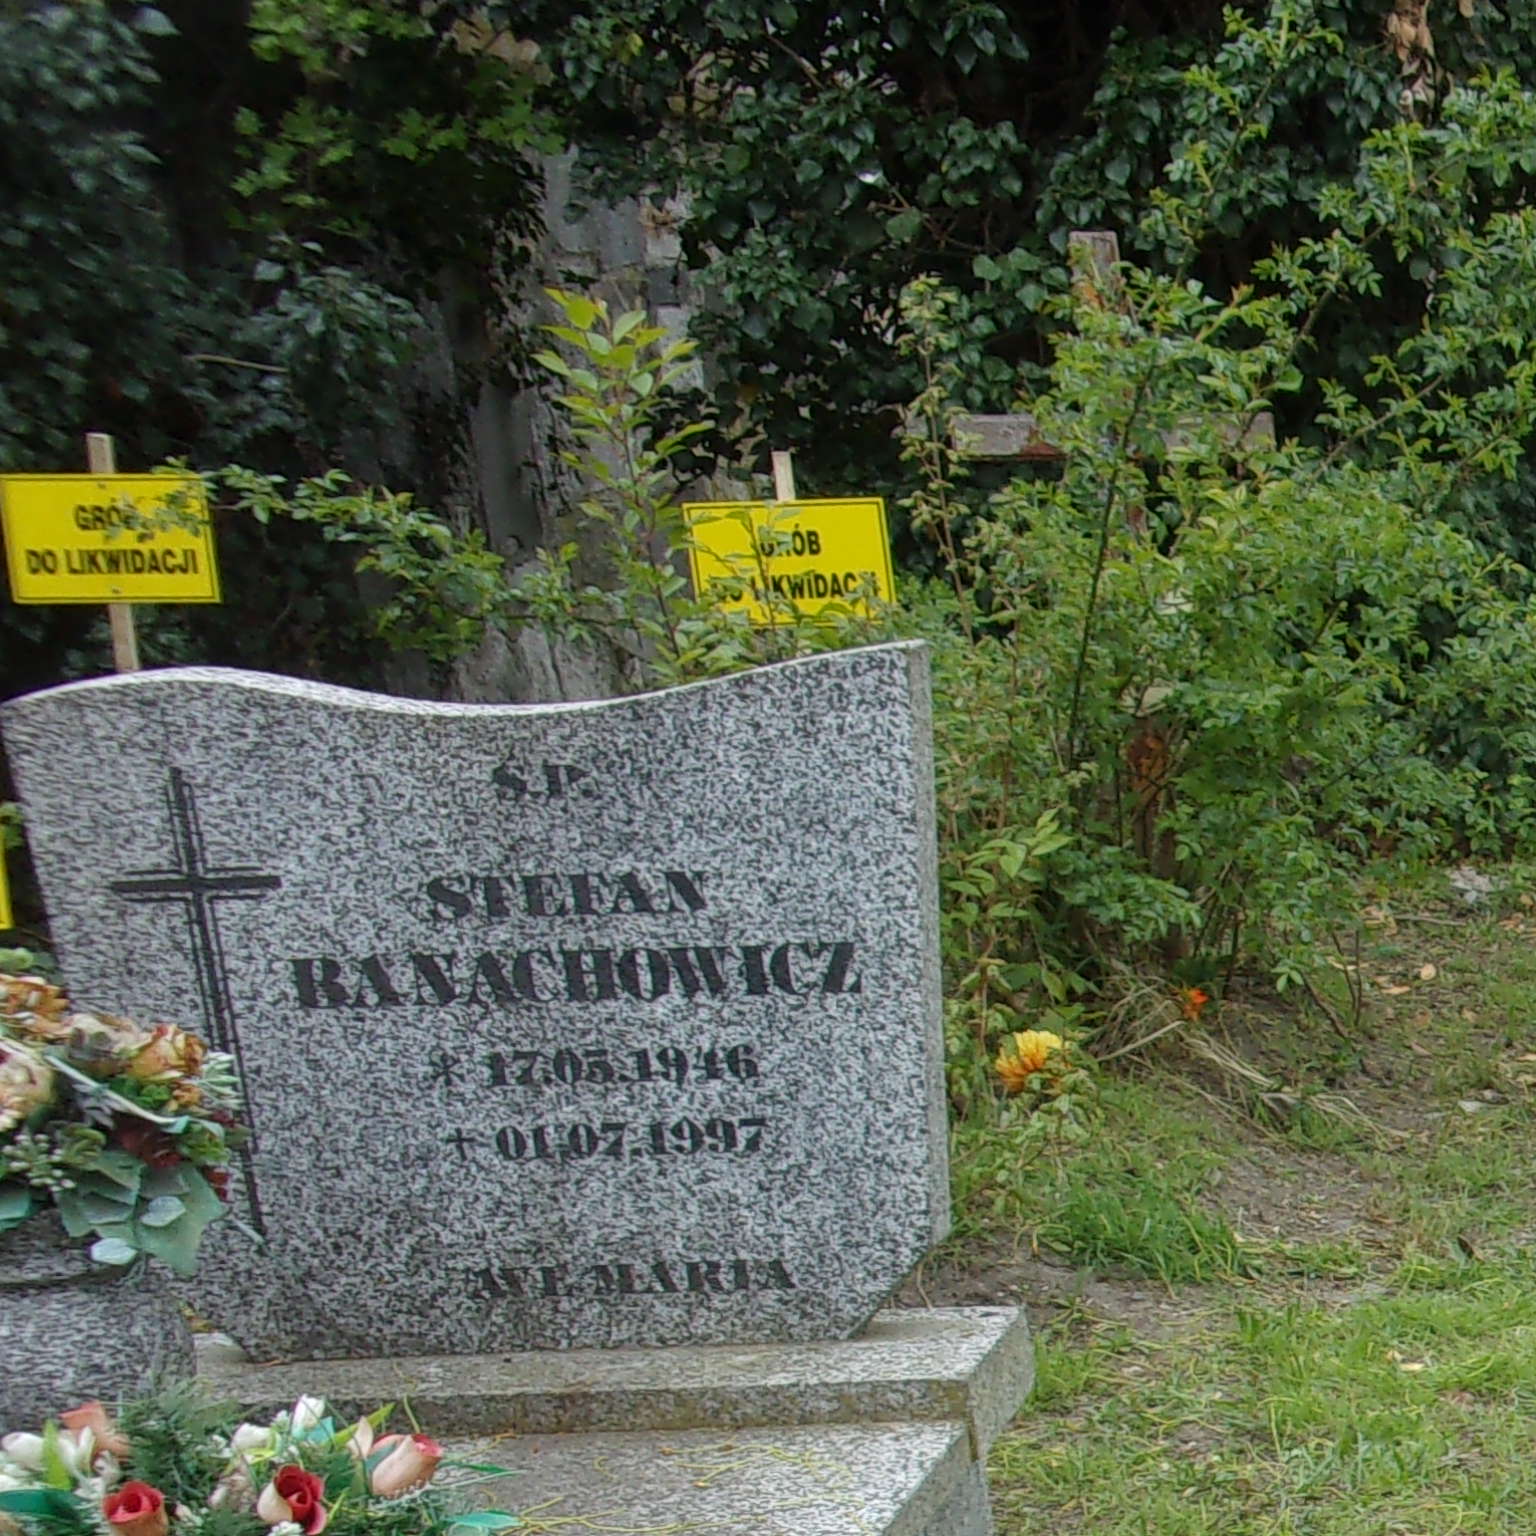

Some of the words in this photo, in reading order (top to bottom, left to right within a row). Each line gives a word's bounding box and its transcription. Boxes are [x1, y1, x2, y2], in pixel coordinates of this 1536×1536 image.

[26, 550, 57, 574] DO
[64, 549, 199, 574] LIKWIDACJI
[425, 872, 707, 920] STEFAN
[496, 1114, 770, 1160] 01.07.1997
[592, 1256, 797, 1295] MARIA
